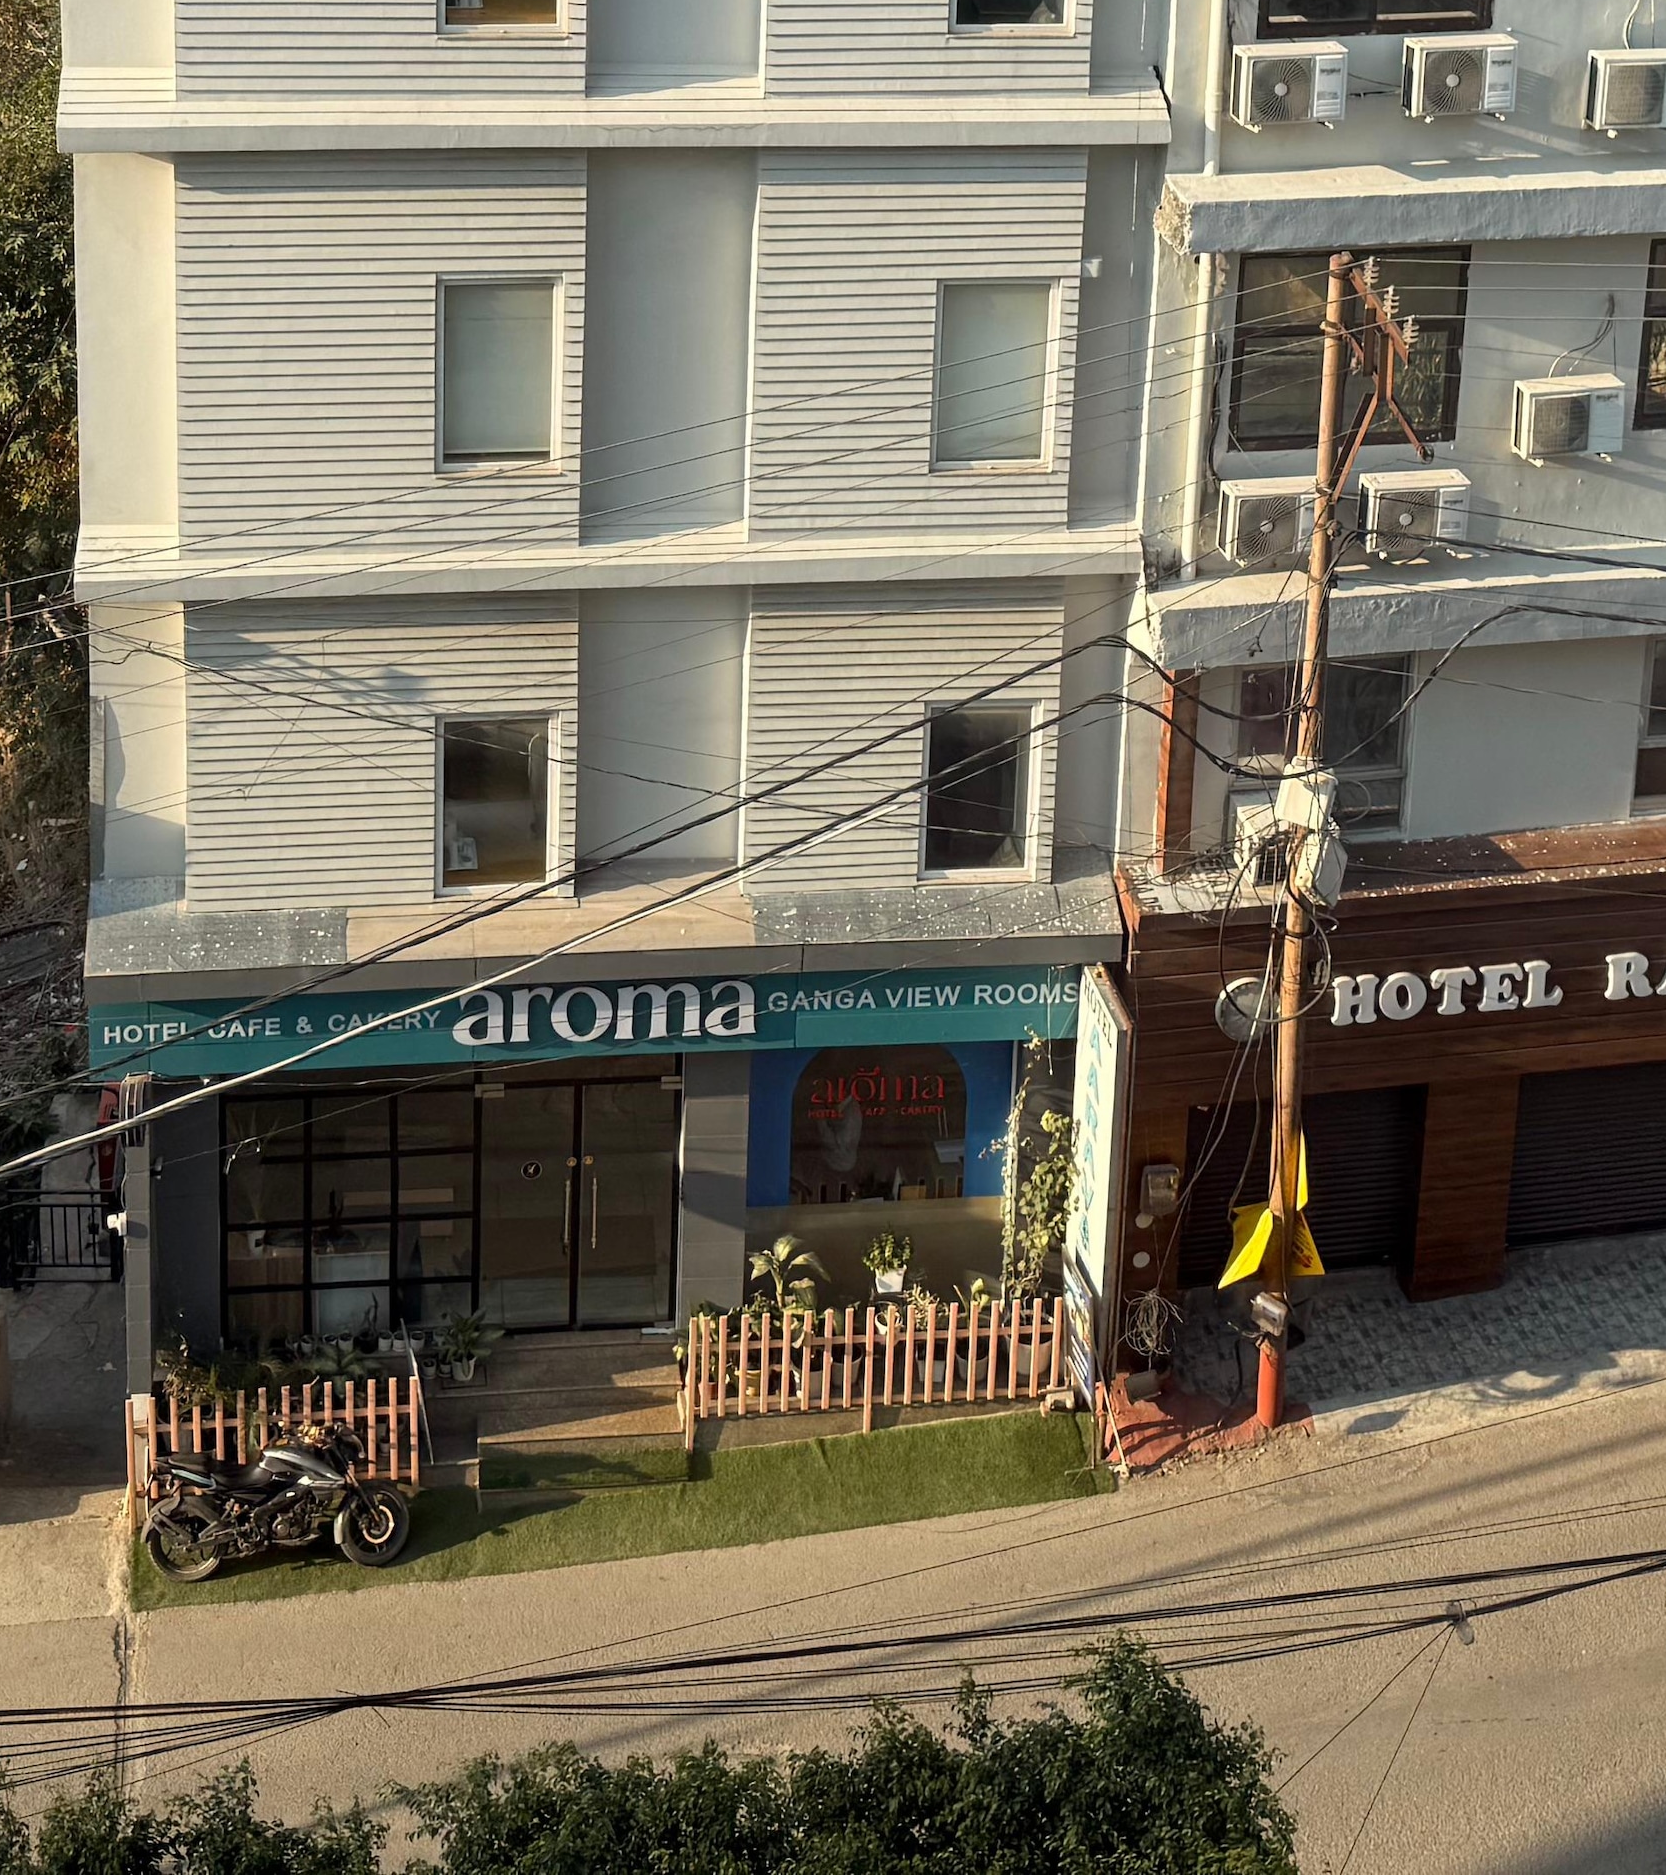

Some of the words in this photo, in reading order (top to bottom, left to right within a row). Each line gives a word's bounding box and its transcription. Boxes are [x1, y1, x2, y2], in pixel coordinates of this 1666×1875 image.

[452, 980, 757, 1046] aroma
[768, 988, 876, 1012] GANGA
[885, 985, 962, 1009] VIEW
[974, 982, 1078, 1005] ROOMS
[1083, 975, 1113, 1049] HOTEL
[1331, 959, 1564, 1026] HOTEL
[104, 1021, 196, 1044] HOTEL
[208, 1017, 281, 1039] CAFE
[296, 1016, 313, 1034] &
